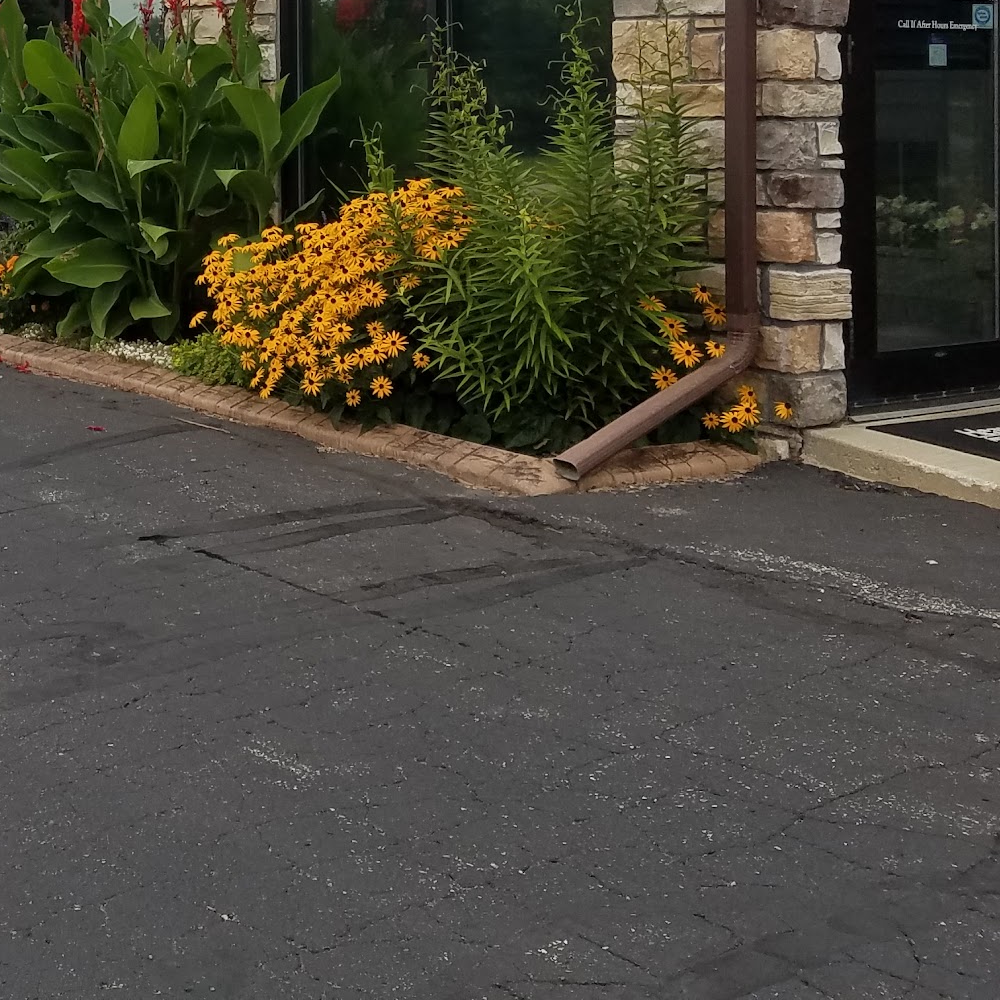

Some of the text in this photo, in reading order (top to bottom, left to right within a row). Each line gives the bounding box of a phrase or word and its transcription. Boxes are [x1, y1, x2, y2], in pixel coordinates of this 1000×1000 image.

[897, 19, 909, 28] Call
[910, 19, 916, 29] If
[916, 20, 931, 29] After
[931, 20, 949, 29] Hours
